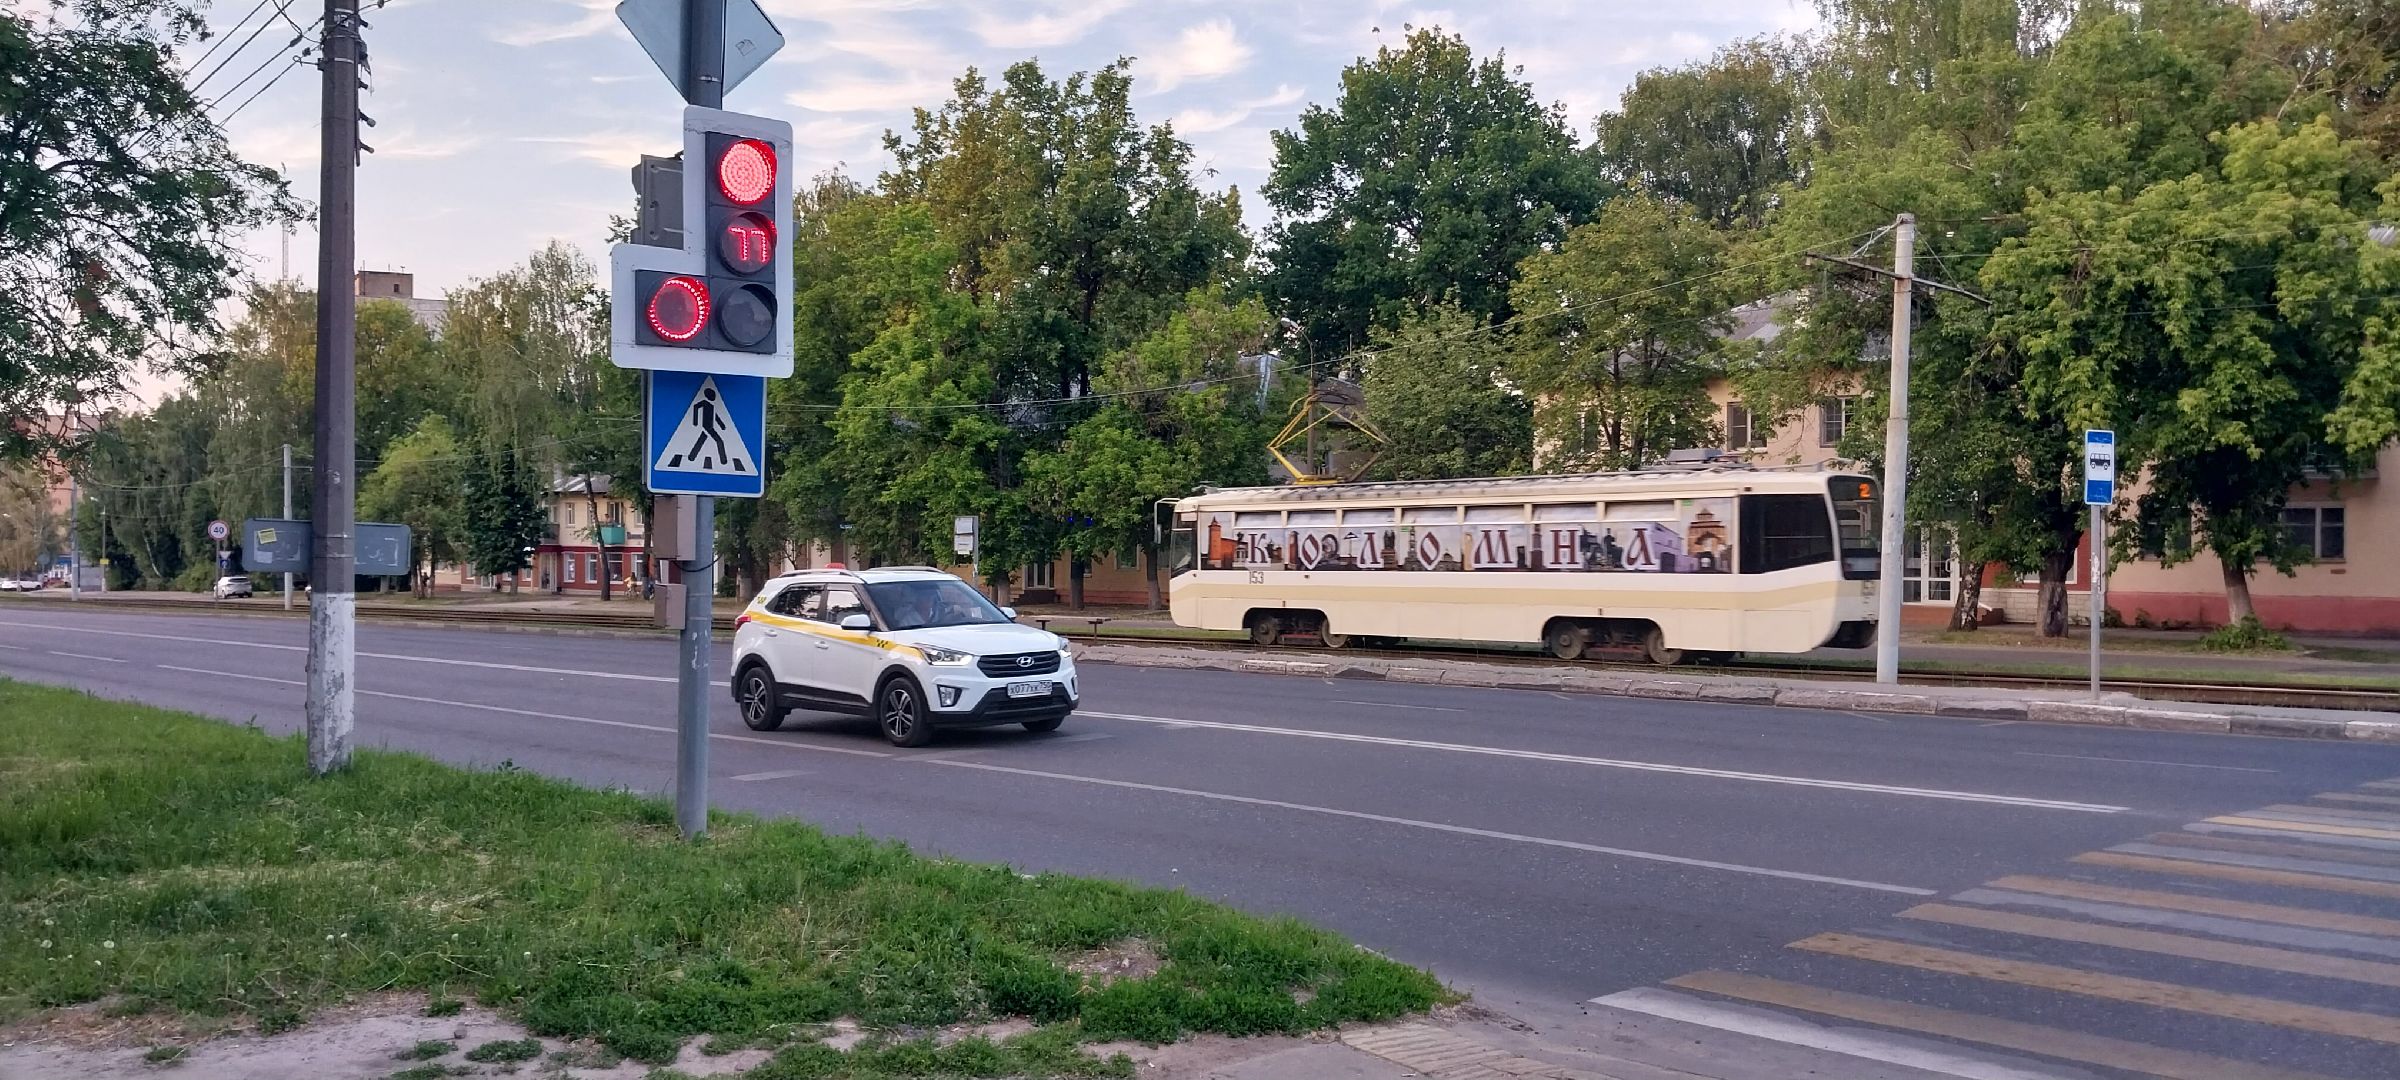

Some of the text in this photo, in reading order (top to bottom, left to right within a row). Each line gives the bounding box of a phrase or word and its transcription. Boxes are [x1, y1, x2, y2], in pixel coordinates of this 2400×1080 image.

[730, 226, 766, 263] 77
[1859, 483, 1871, 498] 2
[213, 526, 225, 535] 40
[1249, 527, 1656, 567] КОЛОМНА
[1249, 570, 1265, 585] 153
